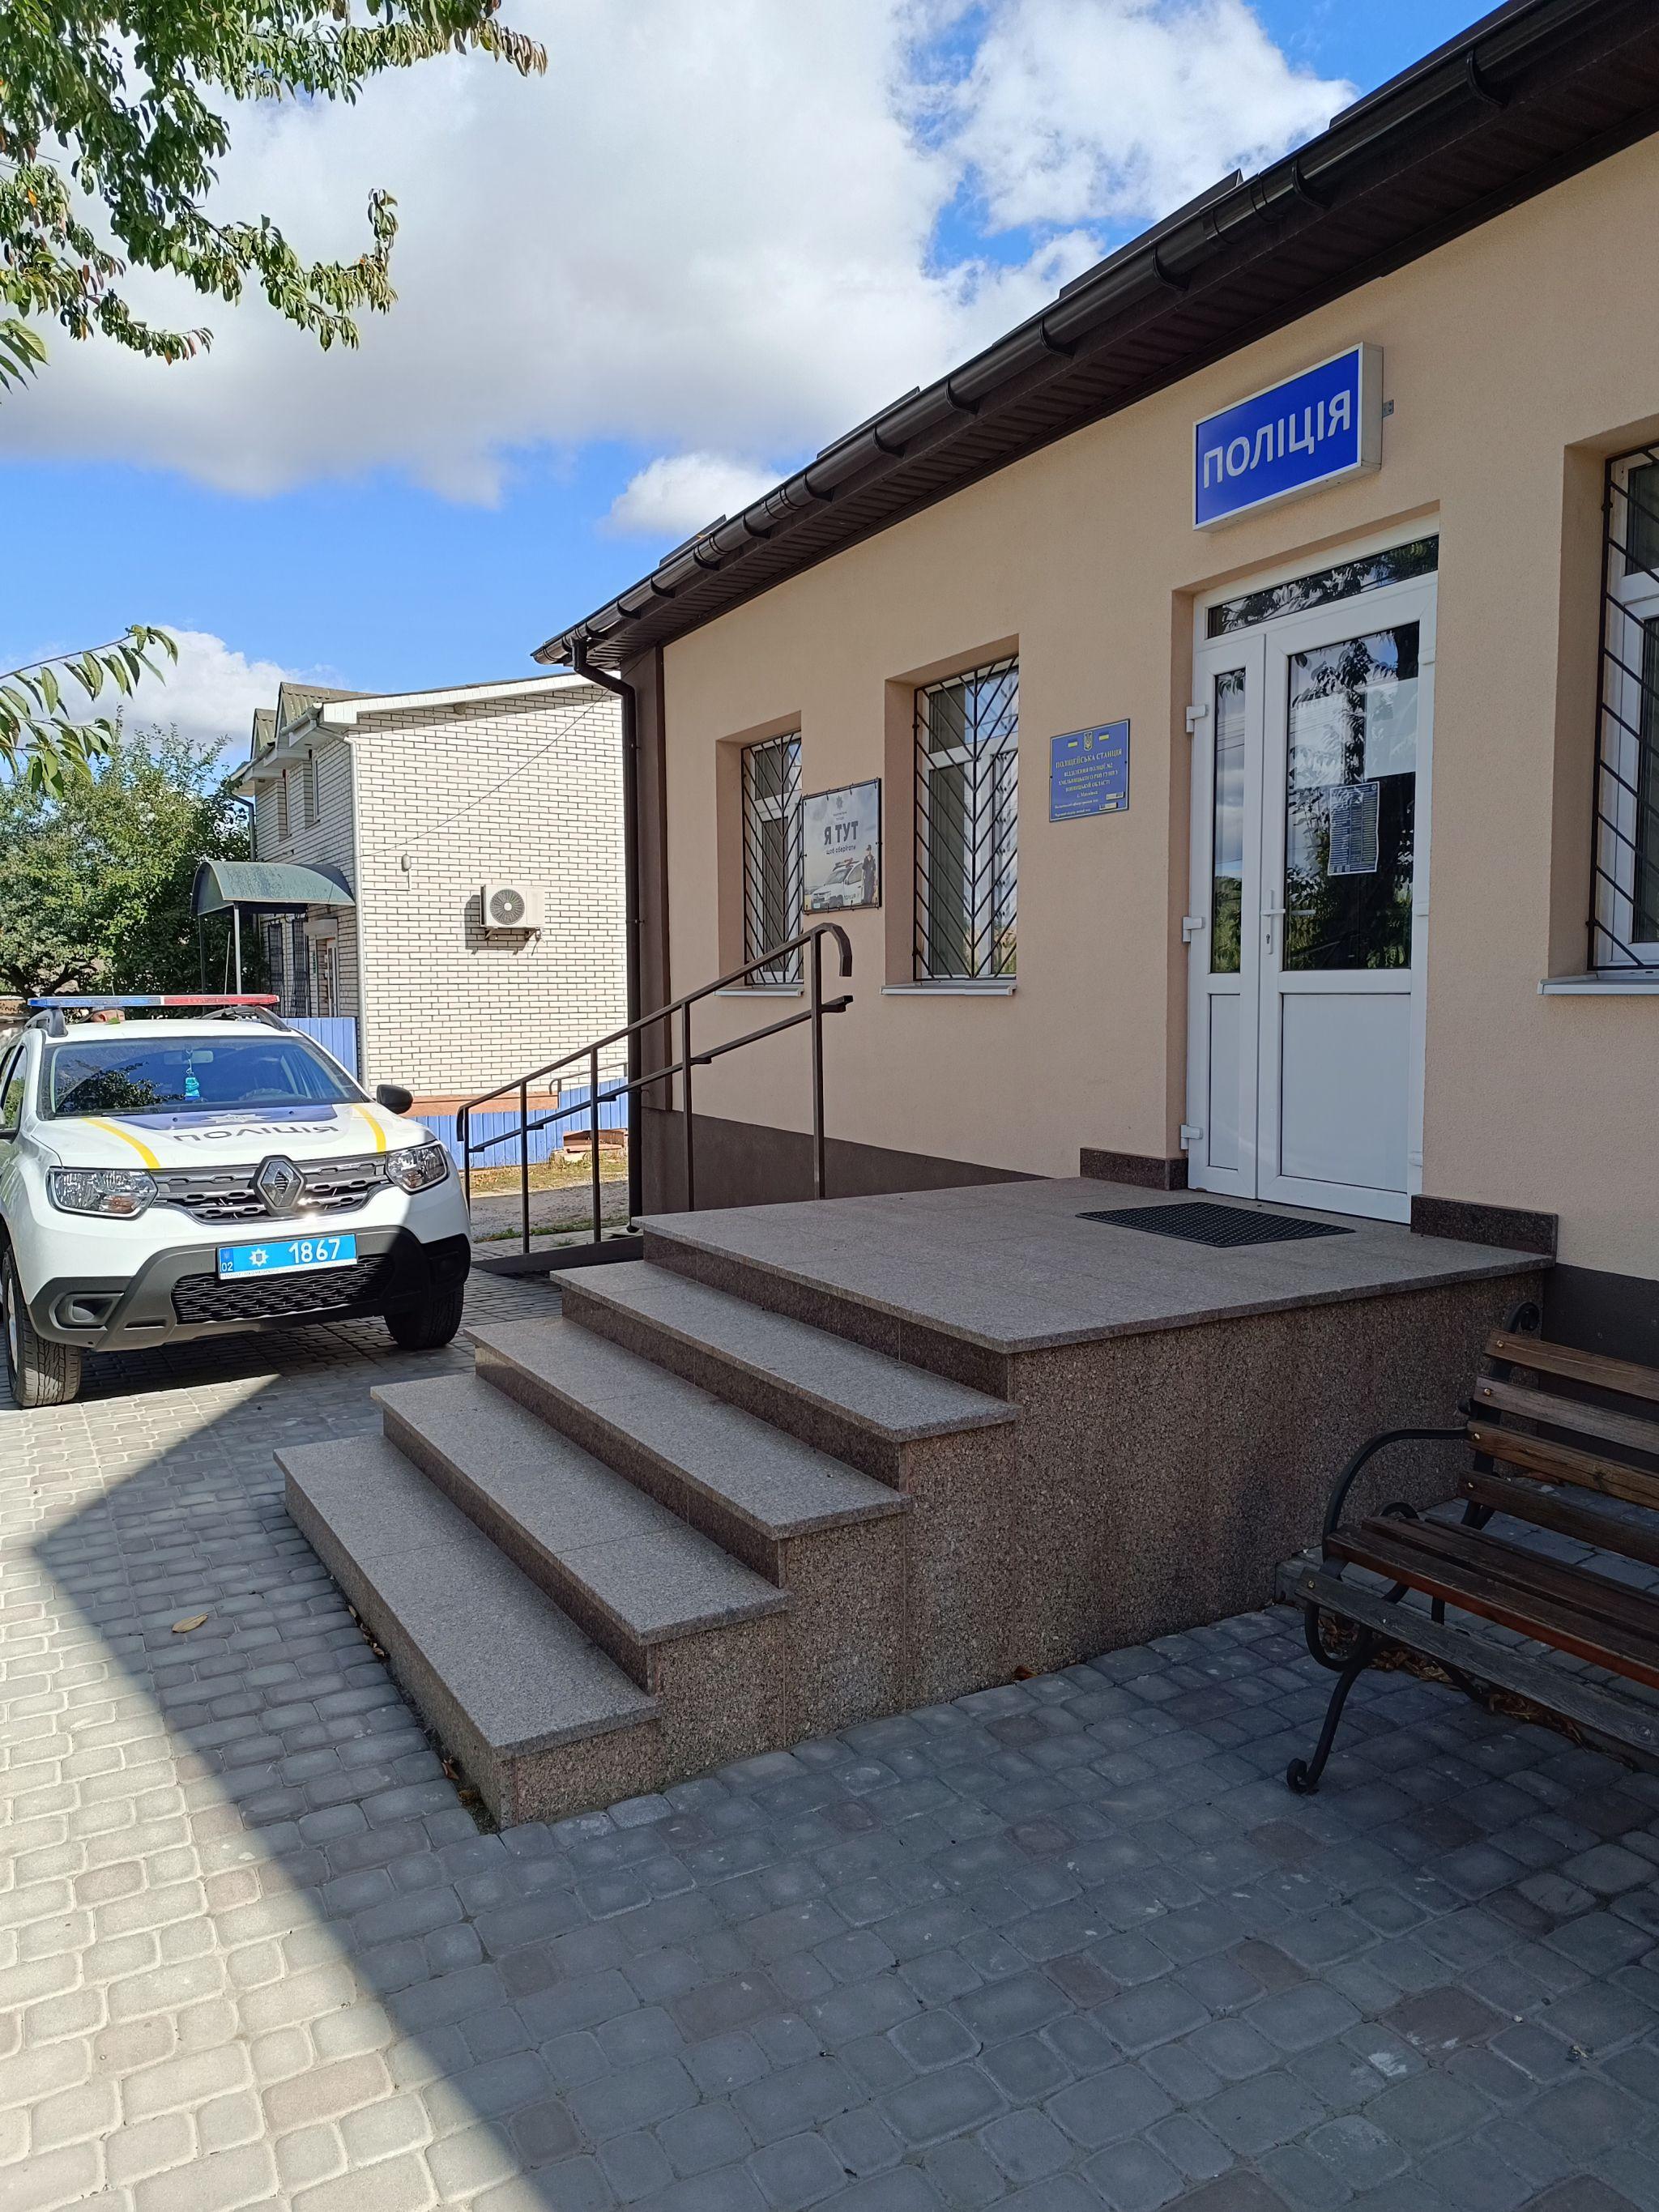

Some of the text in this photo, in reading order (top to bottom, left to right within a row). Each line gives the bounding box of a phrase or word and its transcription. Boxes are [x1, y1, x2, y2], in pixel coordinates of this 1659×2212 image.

[1203, 389, 1351, 489] ПОЛІЦІЯ
[1096, 748, 1122, 760] СТАНЦІЯ
[824, 820, 859, 846] Я ТУТ
[173, 1125, 339, 1142] ПОЛІЦІЯ
[288, 1238, 341, 1264] 1867
[221, 1261, 234, 1272] 02
